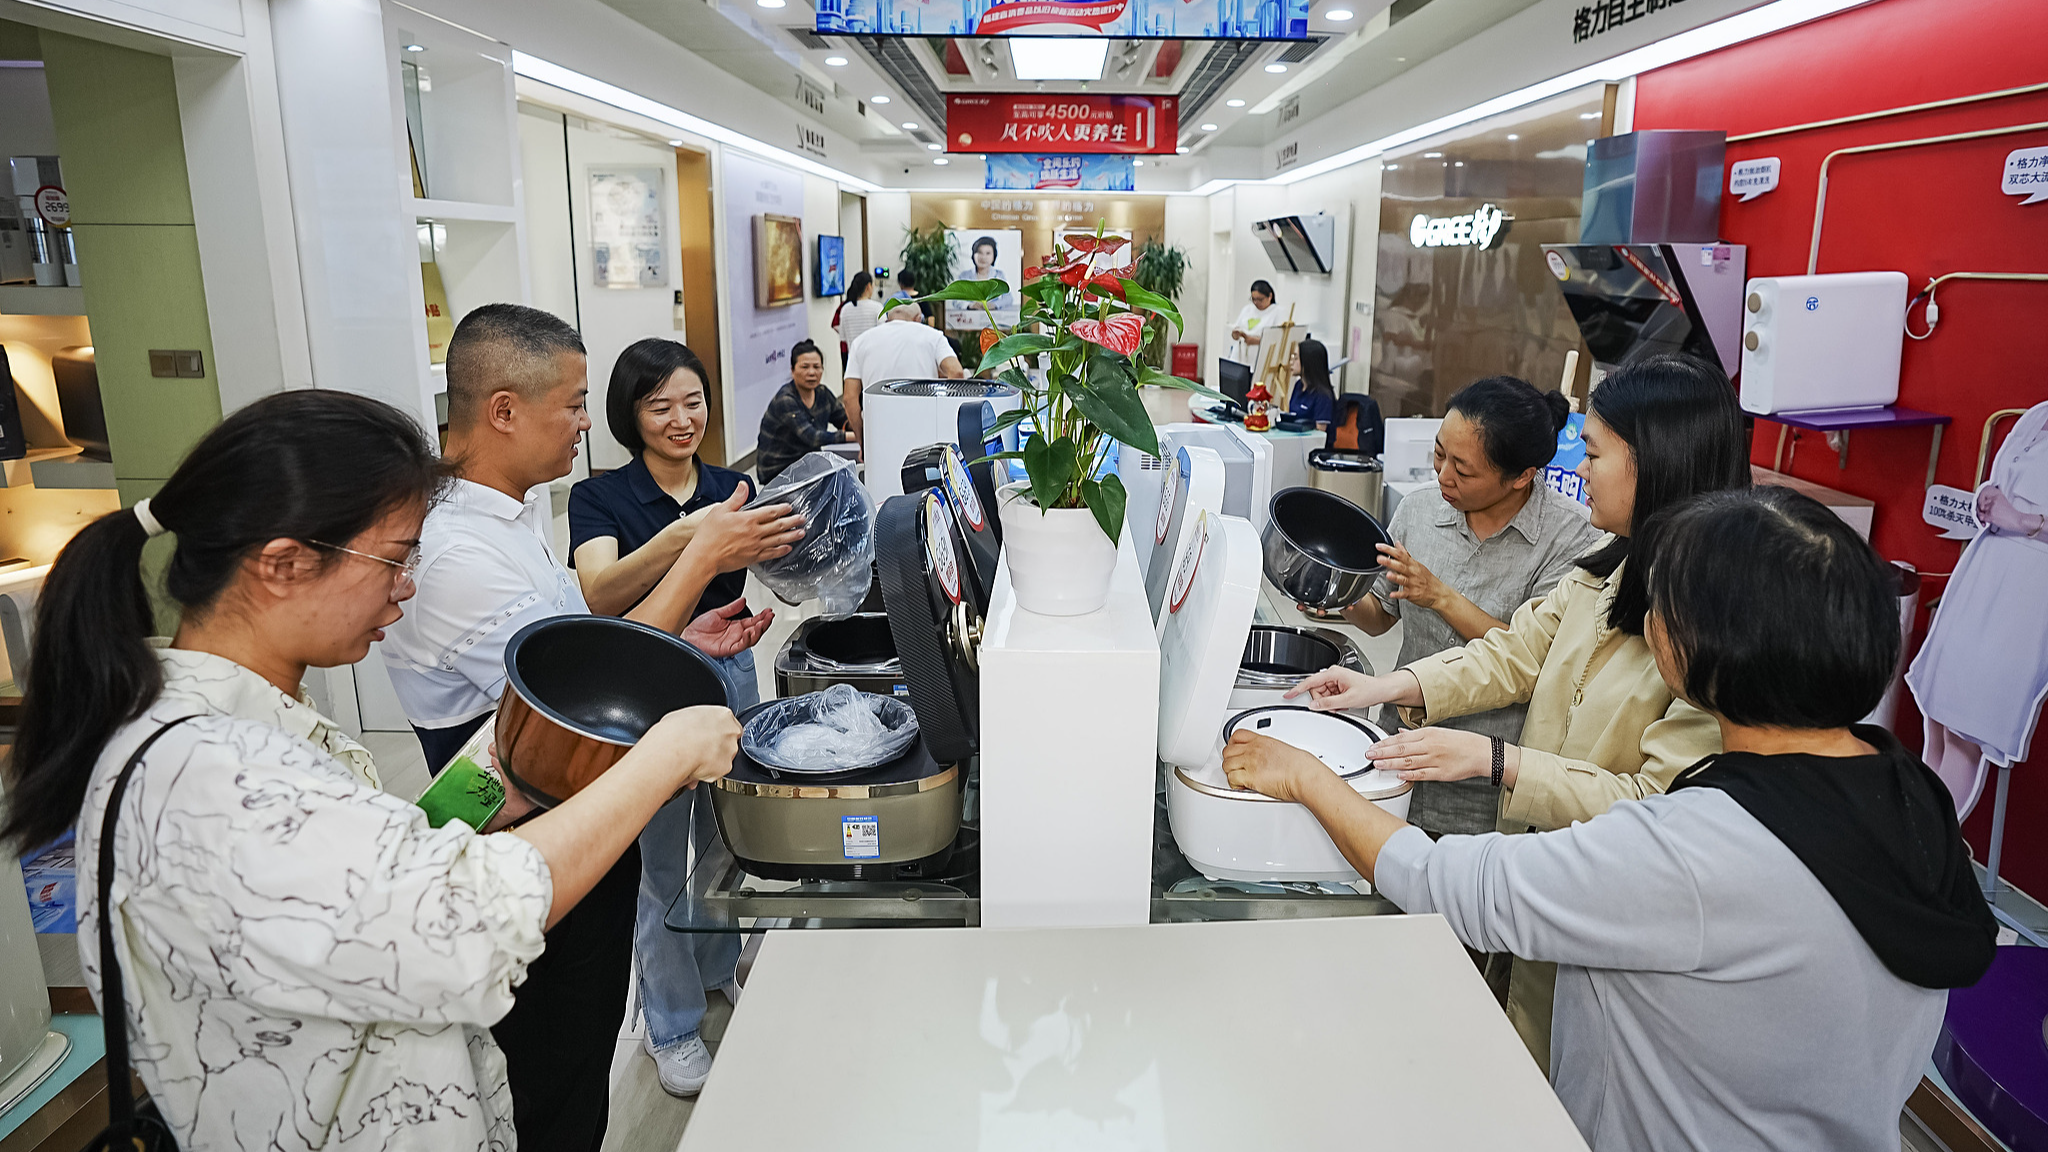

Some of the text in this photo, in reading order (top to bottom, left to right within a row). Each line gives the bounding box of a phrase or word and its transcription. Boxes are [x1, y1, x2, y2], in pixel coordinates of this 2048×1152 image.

[1000, 122, 1128, 143] 风不吹人更养生
[45, 201, 70, 213] 2699
[1929, 505, 1979, 530] 100%杀灭甲
